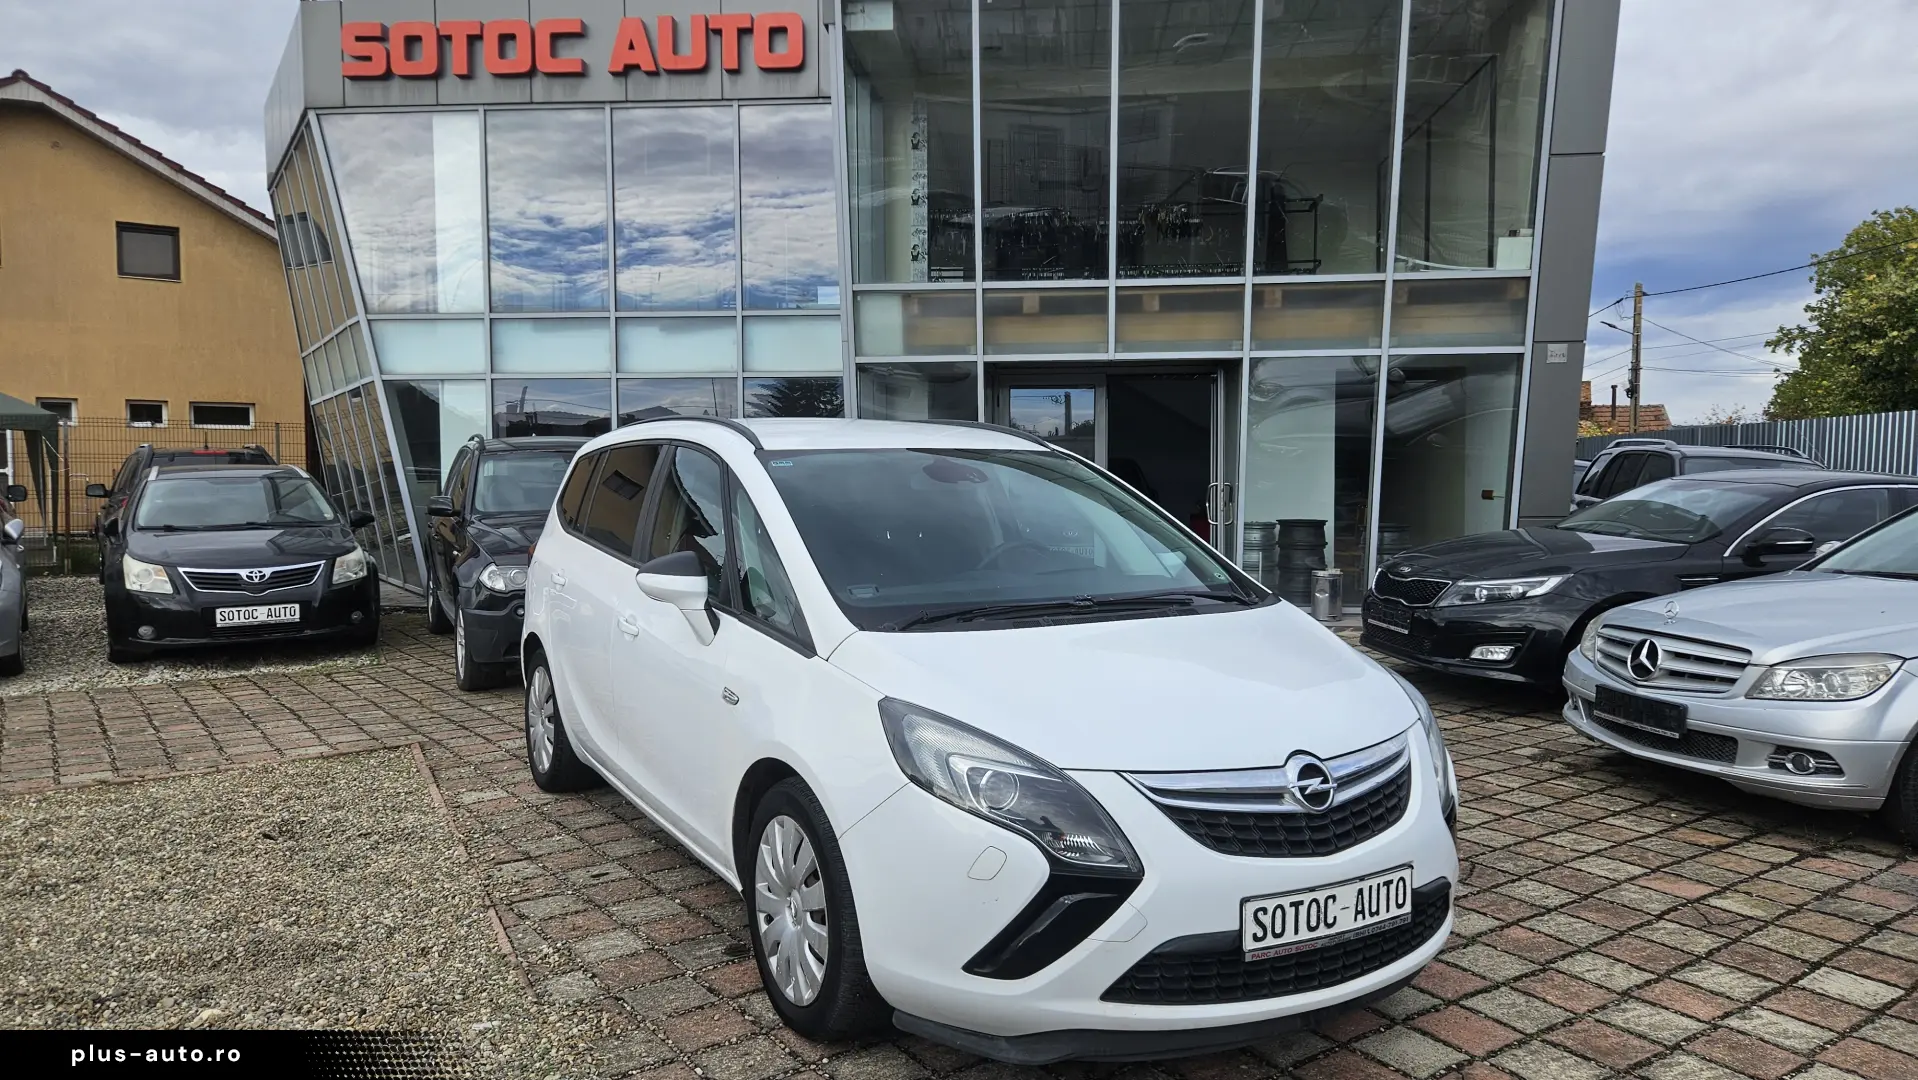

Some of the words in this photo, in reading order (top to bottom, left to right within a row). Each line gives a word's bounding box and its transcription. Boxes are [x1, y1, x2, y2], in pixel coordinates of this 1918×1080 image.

[341, 18, 587, 80] SOTOC
[607, 12, 804, 75] AUTO
[1251, 951, 1271, 960] PARC
[1273, 947, 1293, 956] AUTO
[1294, 942, 1318, 952] SOTOC
